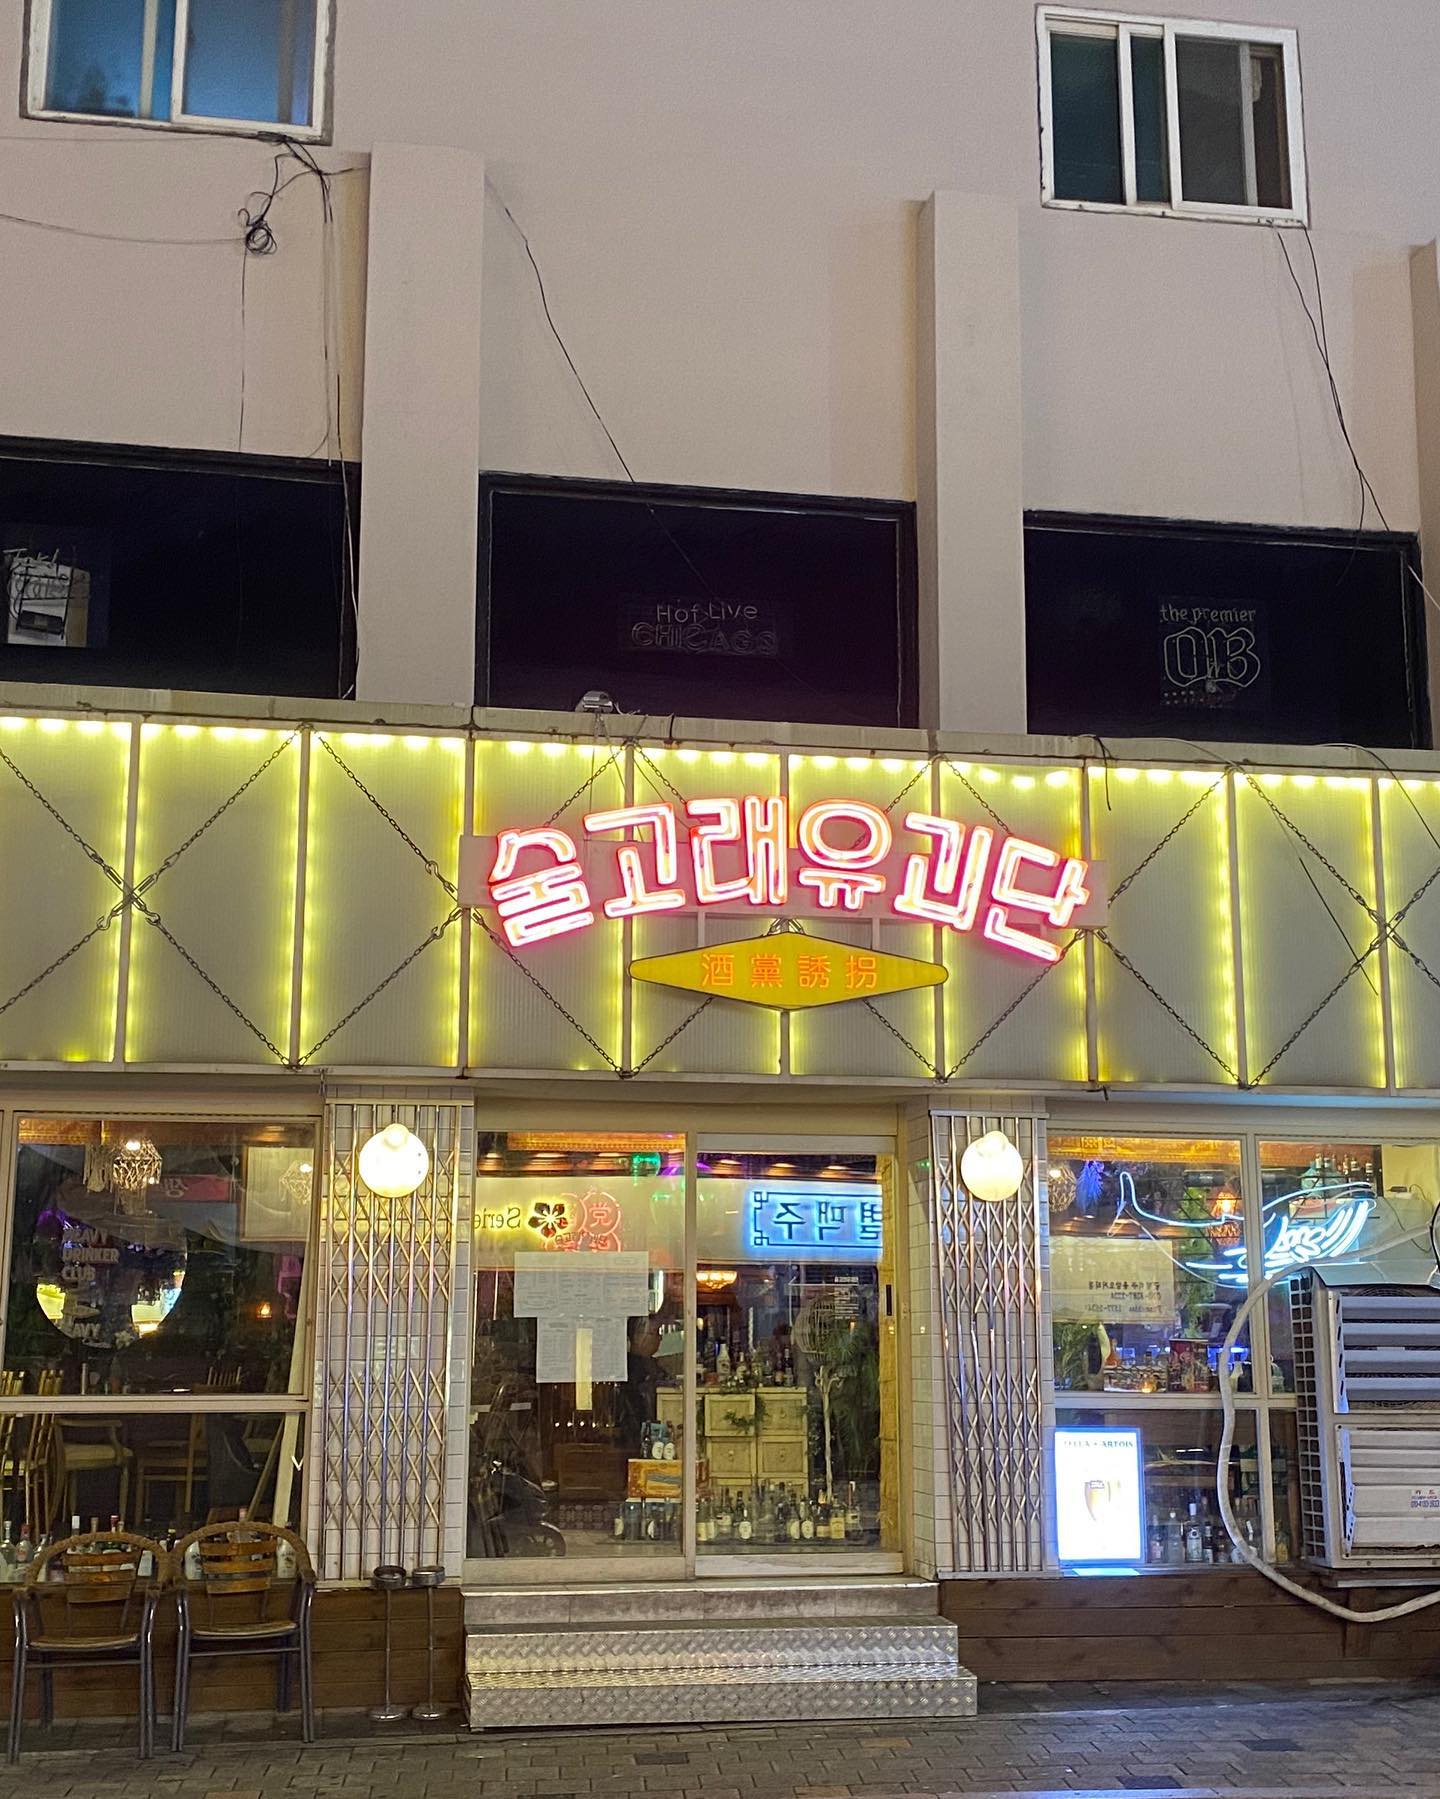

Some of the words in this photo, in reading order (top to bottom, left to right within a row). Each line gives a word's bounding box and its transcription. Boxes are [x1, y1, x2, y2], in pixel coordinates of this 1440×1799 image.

[656, 604, 699, 623] Hof
[708, 601, 759, 621] Live
[1160, 603, 1188, 622] the
[1191, 606, 1256, 625] premier
[1163, 626, 1261, 688] OB
[701, 953, 878, 989] 酒黨誘拐
[62, 1247, 120, 1263] DRINKER
